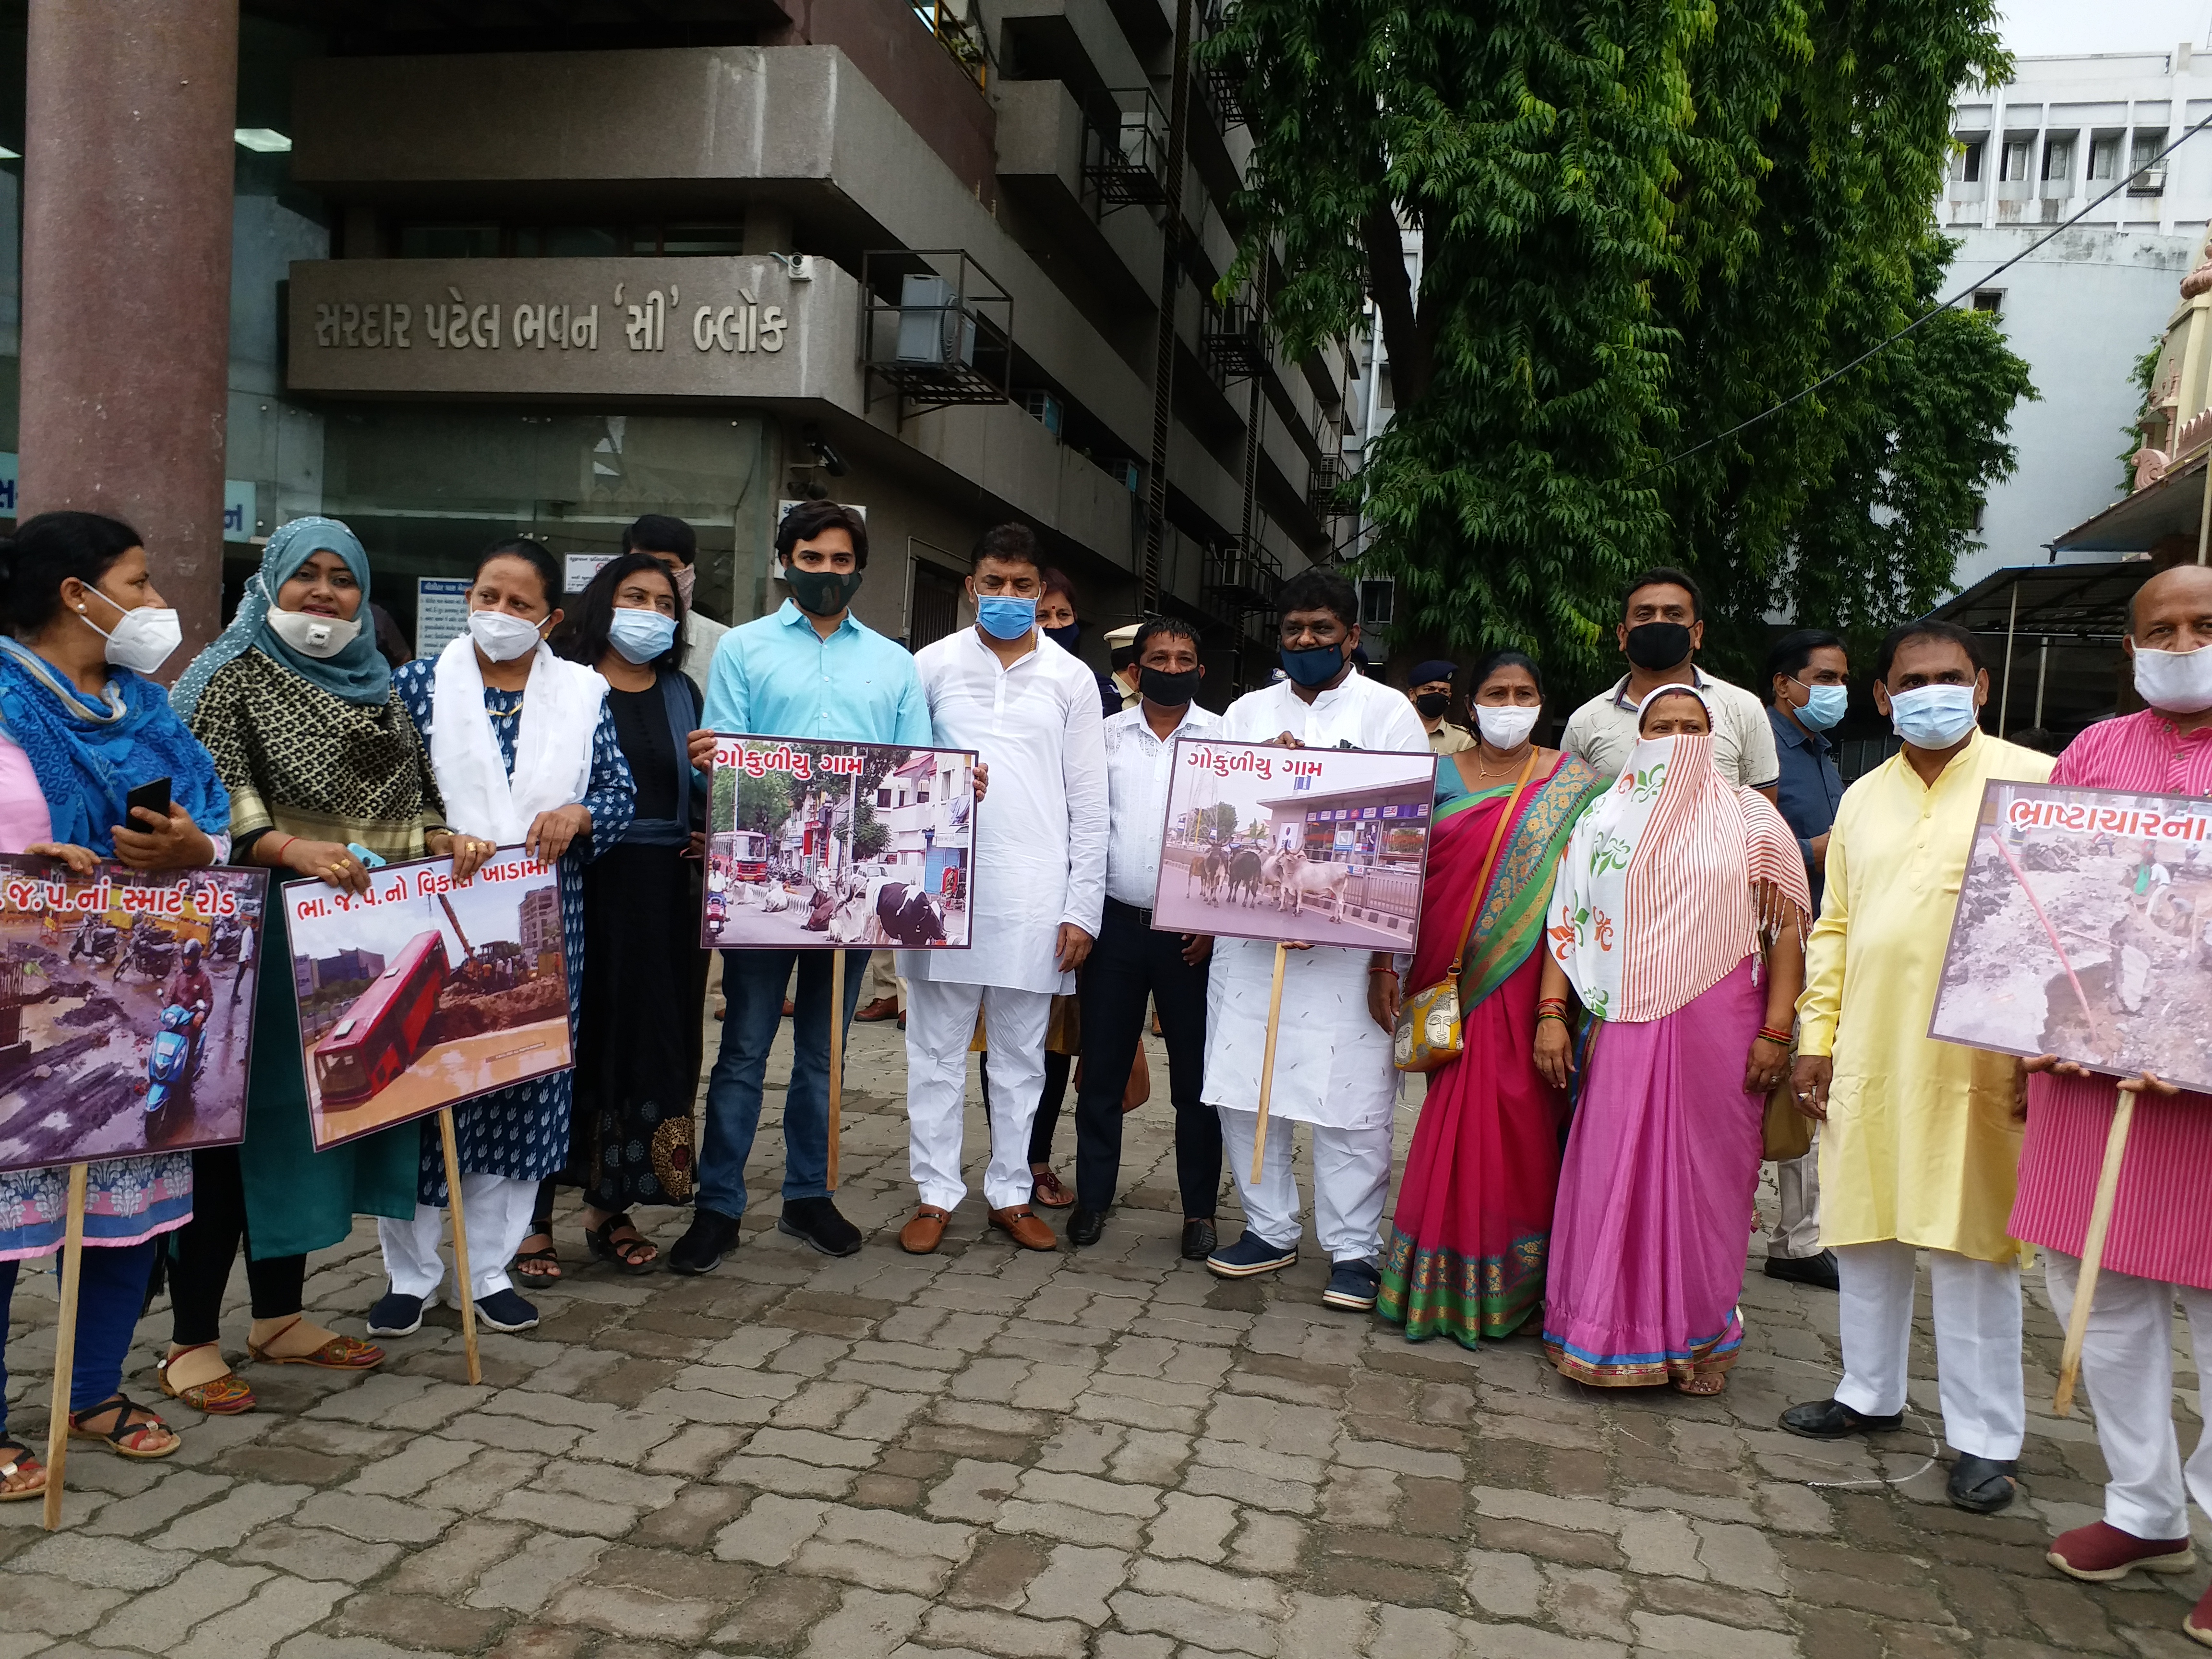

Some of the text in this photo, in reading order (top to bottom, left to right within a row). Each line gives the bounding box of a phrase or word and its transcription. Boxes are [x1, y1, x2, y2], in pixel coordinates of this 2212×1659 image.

[314, 302, 412, 349] સરદાર
[425, 286, 501, 349] પટેલ
[513, 303, 598, 350] ભવન
[693, 288, 788, 352] બ્લોક
[715, 743, 864, 780] ગોકુળીયુ ગામ
[1187, 746, 1323, 781] ગોકુળીયુ ગામ
[121, 879, 190, 914] સ્માર્ટ
[194, 882, 236, 914] રોડ
